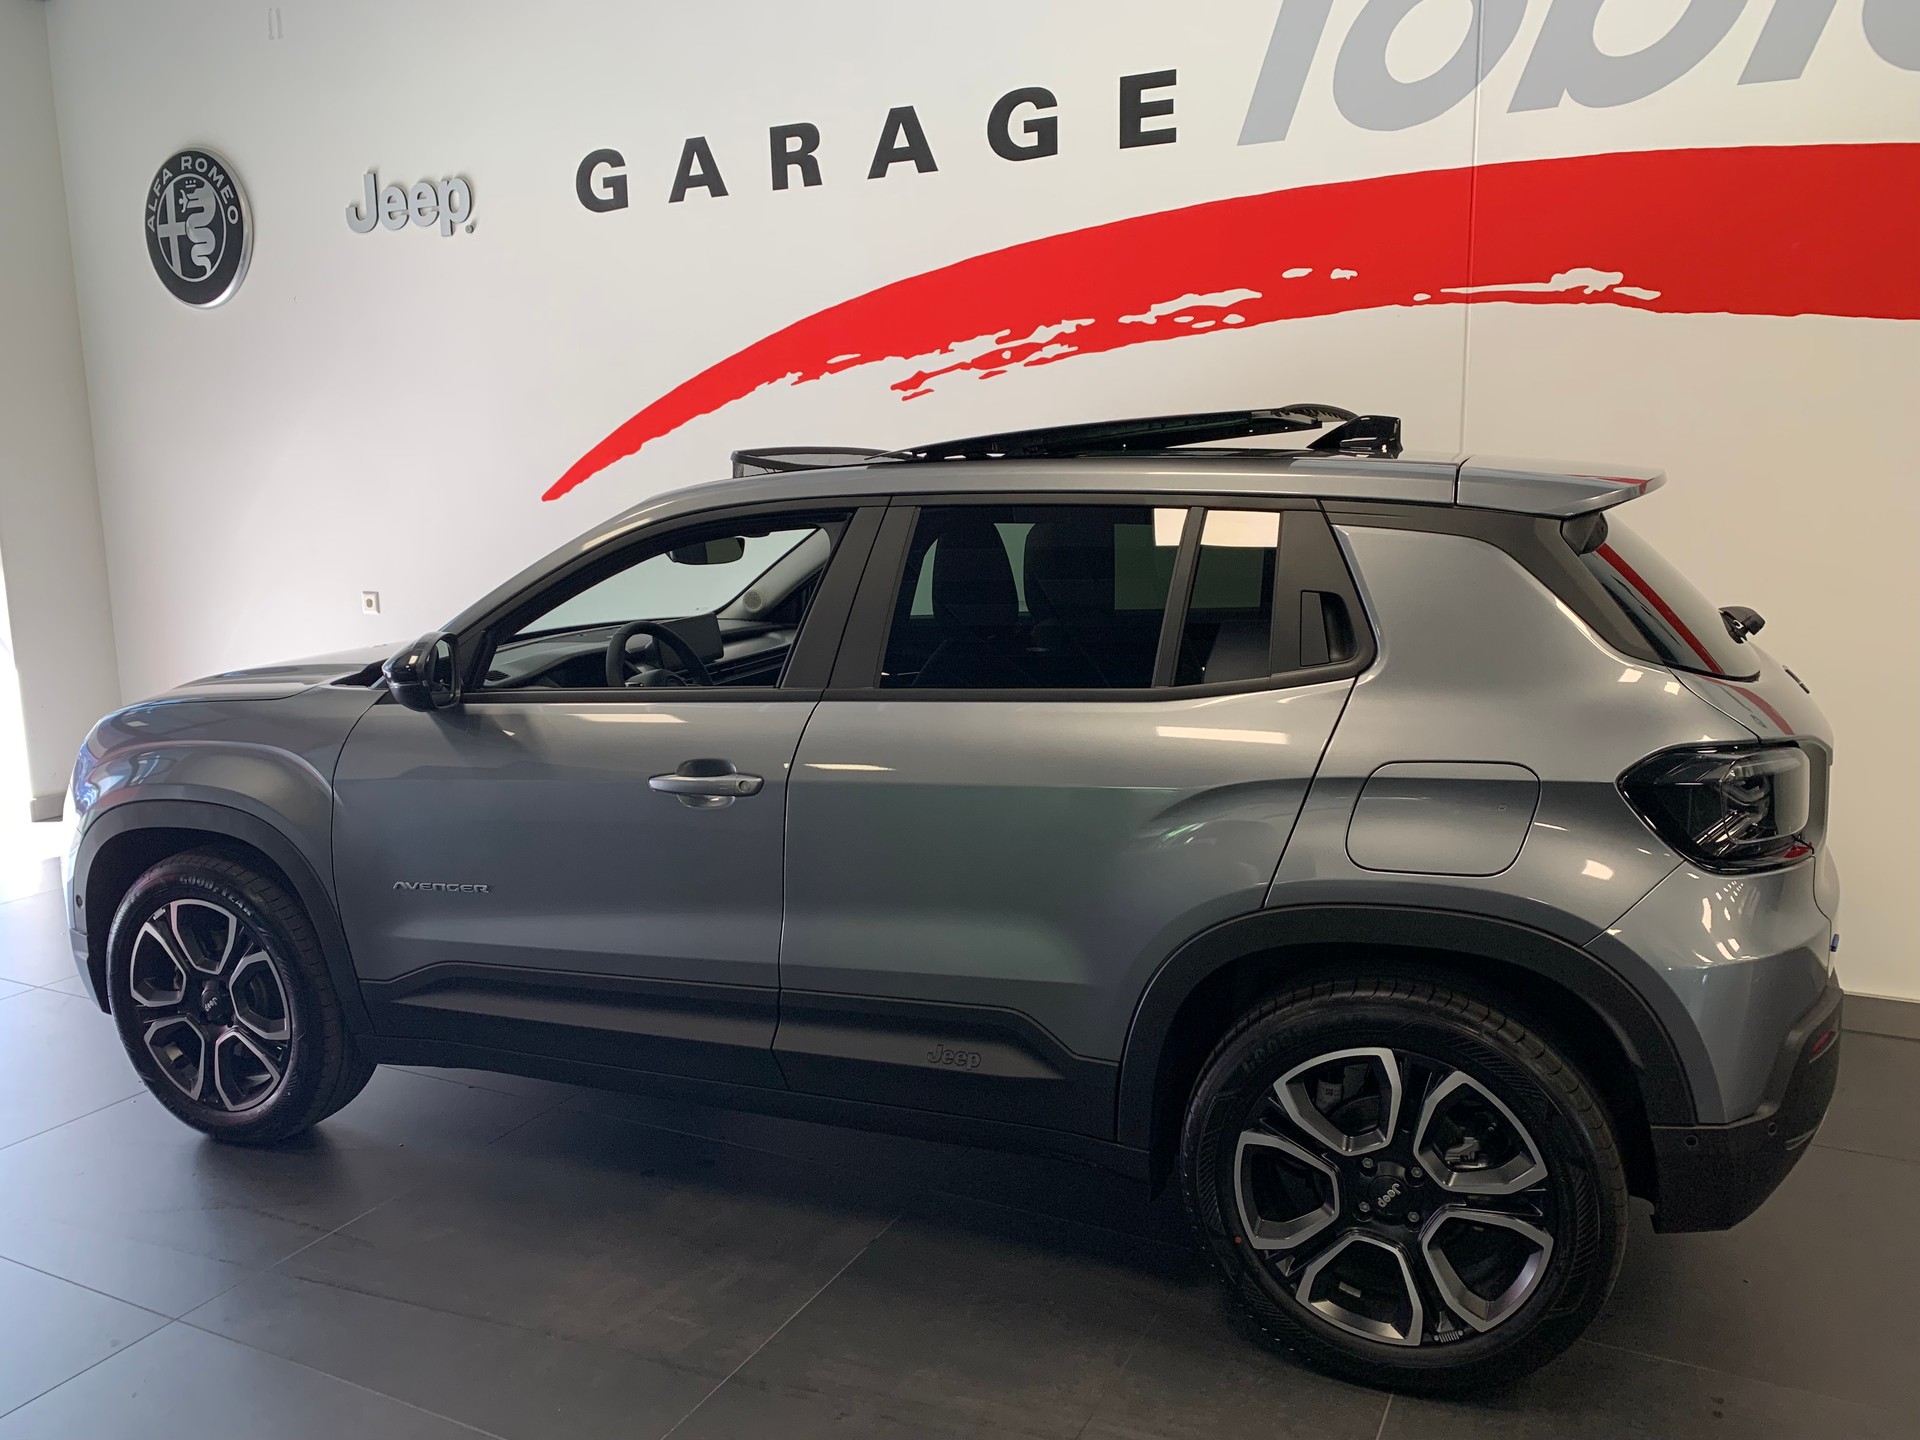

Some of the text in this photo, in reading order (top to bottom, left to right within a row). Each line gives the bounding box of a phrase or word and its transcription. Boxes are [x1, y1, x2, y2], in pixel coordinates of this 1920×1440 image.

[575, 68, 1178, 213] GARAGE
[147, 155, 239, 232] ALFA ROMEO
[345, 172, 472, 237] Jeep
[392, 881, 490, 894] AVENGER
[927, 1043, 982, 1071] Jeep
[1377, 1182, 1401, 1208] Jeep
